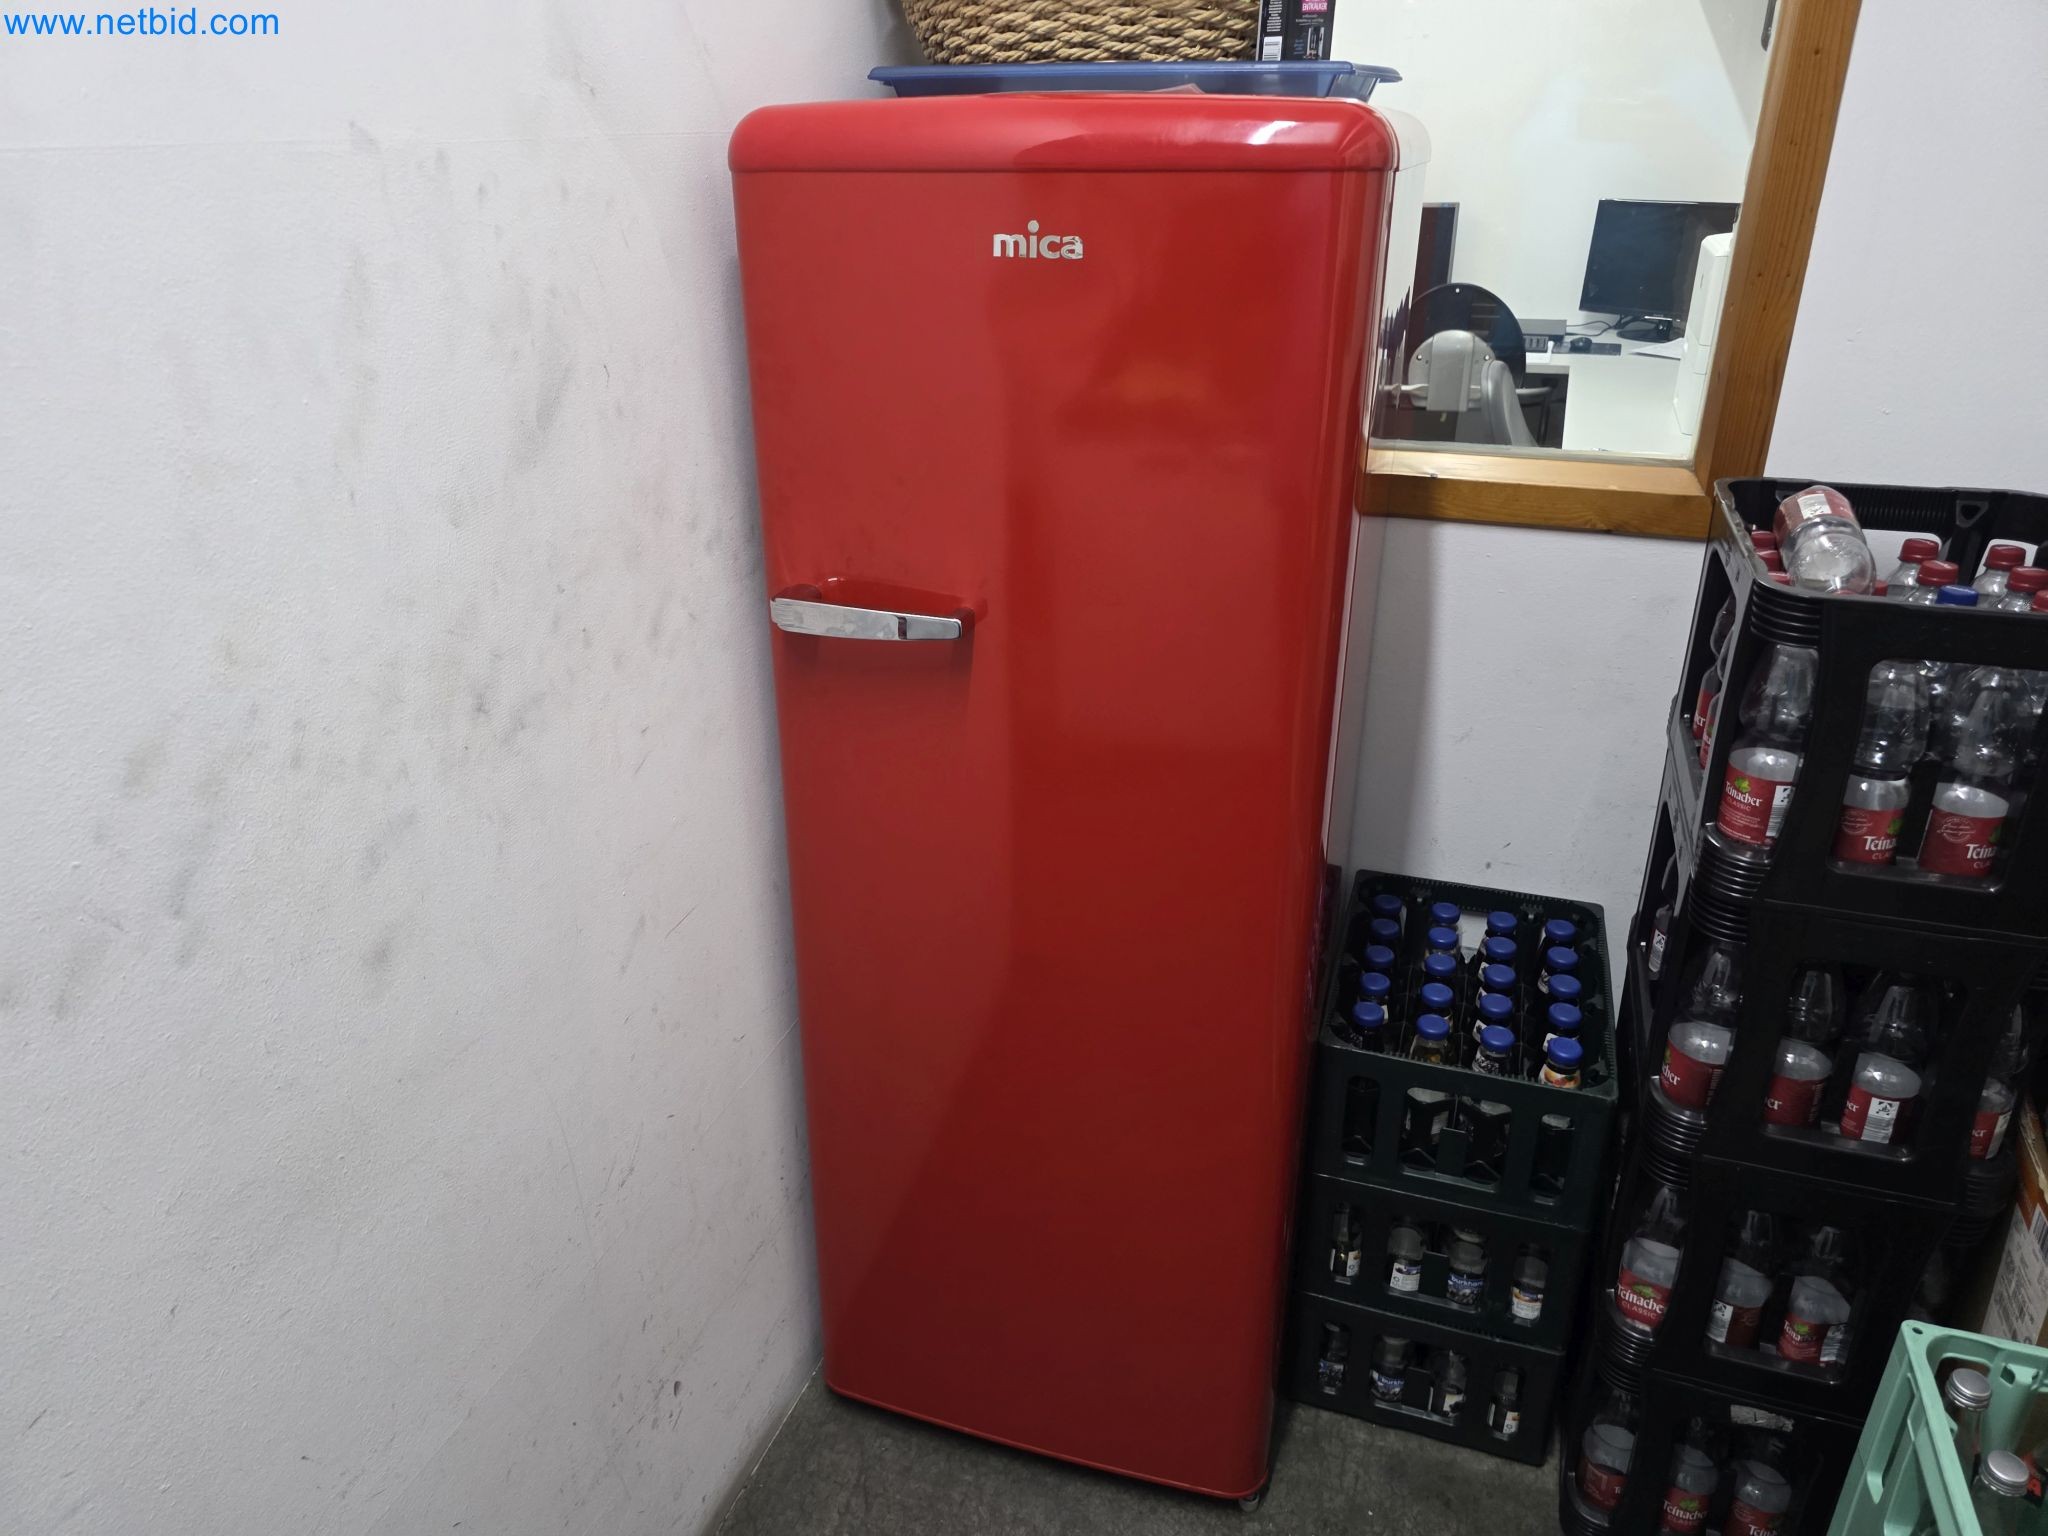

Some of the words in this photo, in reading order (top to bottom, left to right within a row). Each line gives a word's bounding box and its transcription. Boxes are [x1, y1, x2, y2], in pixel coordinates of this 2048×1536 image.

[993, 220, 1084, 259] mica
[1725, 780, 1763, 807] Teinacher
[1621, 1301, 1657, 1319] CLASSIC
